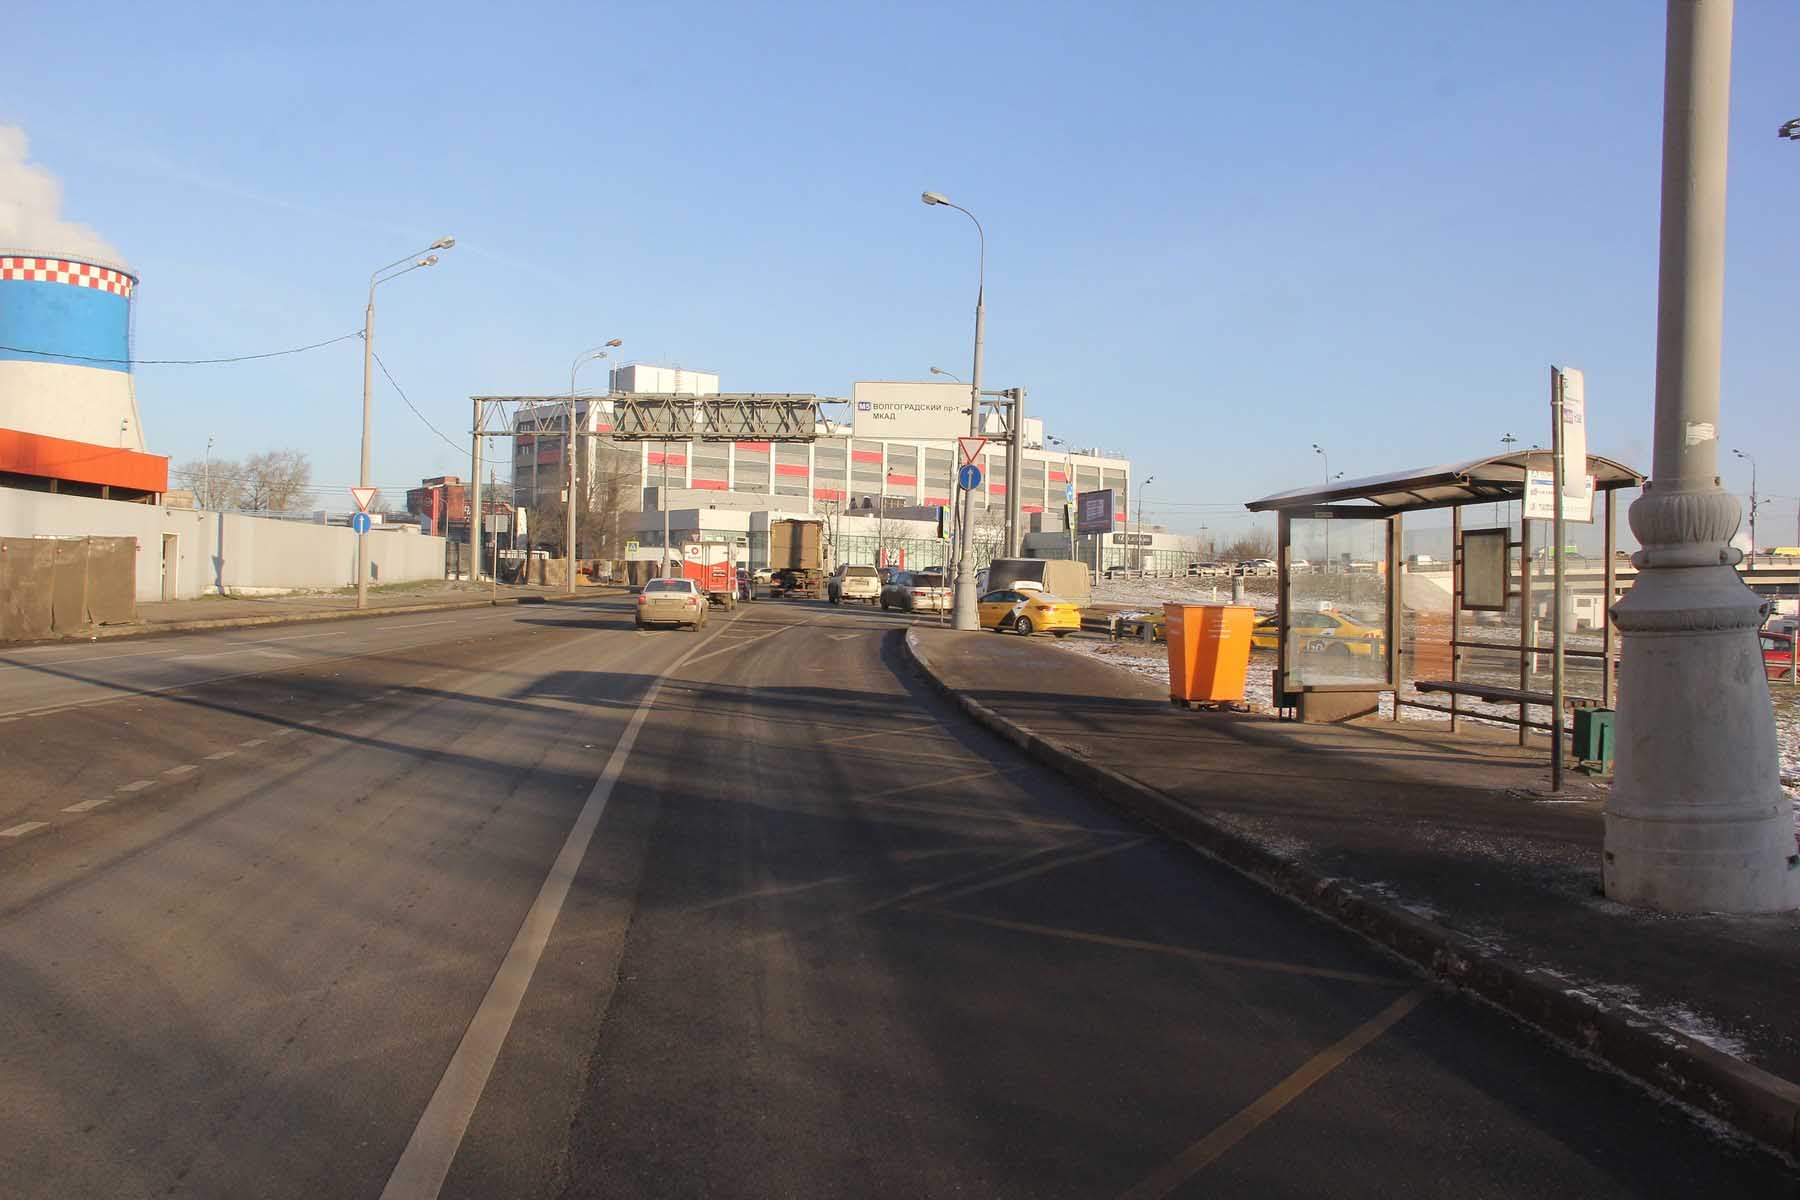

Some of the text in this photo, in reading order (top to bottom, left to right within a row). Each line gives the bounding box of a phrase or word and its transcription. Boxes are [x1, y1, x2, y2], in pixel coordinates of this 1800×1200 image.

[873, 403, 941, 411] ВОЛГОГРАДСКИЙ
[943, 405, 959, 413] пр-т
[873, 412, 896, 420] МКАД
